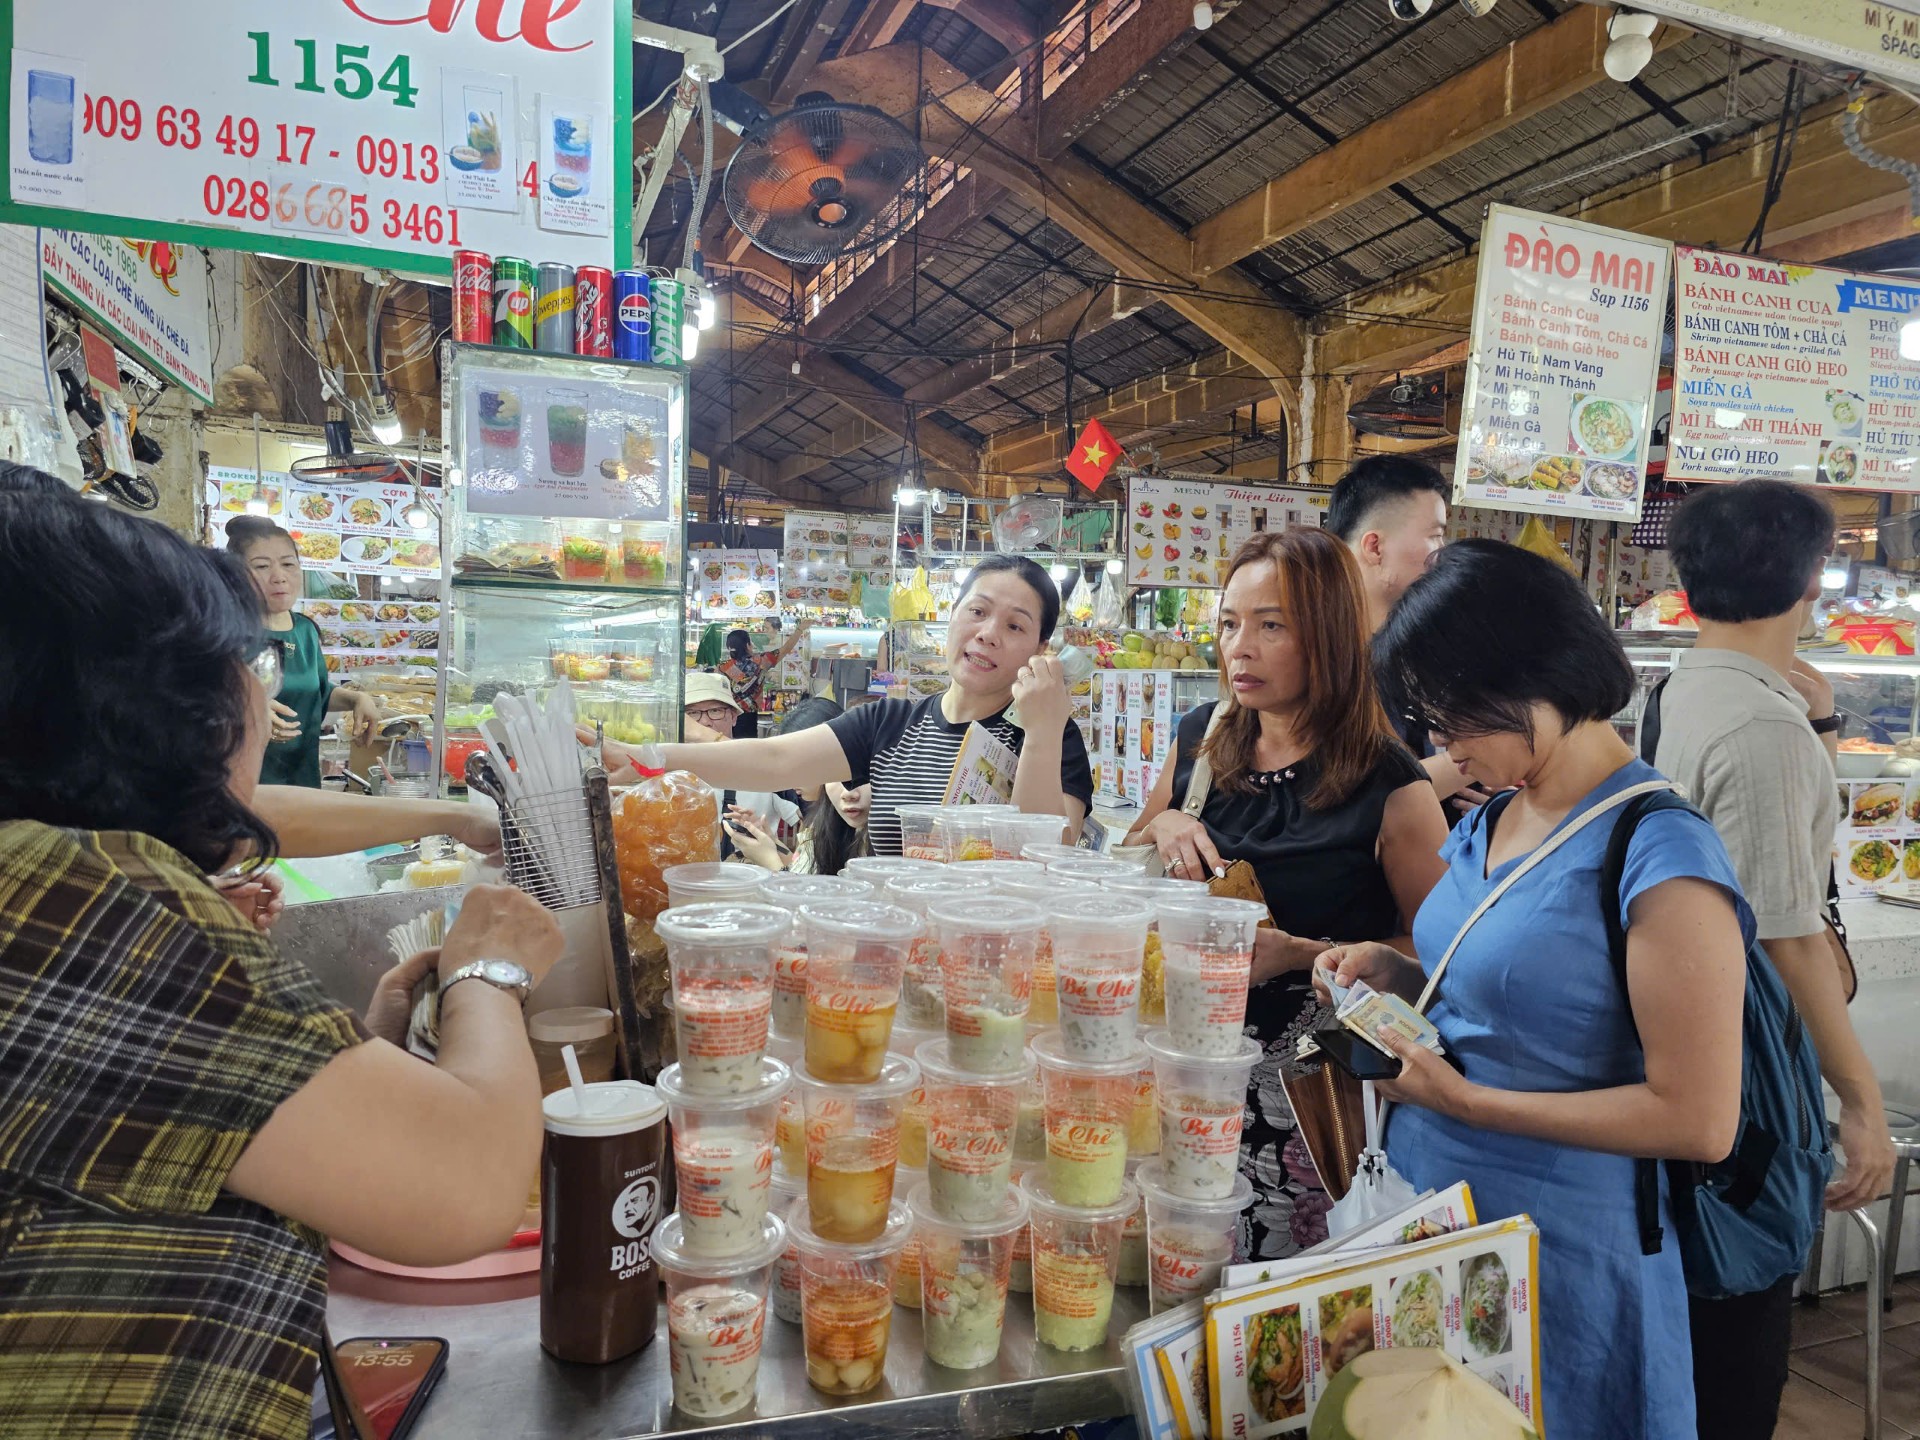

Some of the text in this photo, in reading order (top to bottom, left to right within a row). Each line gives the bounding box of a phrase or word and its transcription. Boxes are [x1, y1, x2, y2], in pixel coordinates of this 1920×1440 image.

[1881, 34, 1920, 59] SPAG
[247, 31, 419, 108] 1154
[157, 105, 201, 149] 63
[216, 114, 260, 158] 49
[277, 123, 316, 165] 17
[357, 134, 439, 184] 0913
[383, 198, 463, 247] 3461
[70, 231, 90, 264] CÁC
[92, 255, 113, 287] LOẠI
[116, 276, 133, 303] CHÈ
[116, 246, 138, 283] 1968
[1503, 225, 1655, 294] ĐÀO MAI
[1694, 256, 1740, 279] ĐÀO
[538, 294, 571, 316] hweppes
[1503, 294, 1599, 323] Bánh Canh Cua
[1590, 288, 1649, 312] Sạp 1156
[1684, 282, 1832, 316] BÁNH CANH CUA
[107, 299, 121, 325] CÁC
[621, 308, 651, 320] PEPS
[1692, 301, 1842, 328] Crab vietnamese udon (noodle soup)
[1869, 316, 1899, 333] PHỞ
[1501, 311, 1535, 329] Bánh
[1539, 318, 1570, 335] Canh
[1607, 329, 1629, 346] Chả
[1633, 333, 1648, 349] Cá
[1685, 313, 1720, 332] BÁNH
[1724, 320, 1760, 337] CANH
[1763, 322, 1790, 340] TÔM
[1803, 326, 1828, 344] CHẢ
[1831, 329, 1847, 346] CÁ
[1500, 328, 1619, 360] Bánh Canh Giò Heo
[1690, 332, 1841, 357] Shrimp vietnamese udon grilled fish
[1498, 346, 1604, 377] Hủ Tíu Nam Vang
[1684, 344, 1847, 377] BÁNH CANH GIÒ HEO
[1495, 365, 1596, 391] Mì Hoành Thánh
[1690, 364, 1829, 386] Pork sausage legs vietnamese udon
[1870, 372, 1920, 391] PHỞ TÔ
[1493, 381, 1508, 395] Mì
[1682, 377, 1752, 399] MIẾN GÀ
[1688, 397, 1795, 414] Soya noodles with chicken
[1489, 415, 1541, 433] Miến Gà
[1679, 410, 1822, 437] MÌ HNH THÁNH
[1711, 445, 1740, 463] GIÒ
[1745, 449, 1779, 465] HEO
[1681, 462, 1699, 472] Pork
[1701, 464, 1736, 475] sausage
[1738, 465, 1754, 476] legs
[1174, 486, 1211, 496] MENU
[1060, 975, 1136, 999] Bé Chè
[829, 992, 879, 1015] Chè
[1068, 1125, 1115, 1145] Chè
[1180, 1114, 1243, 1136] Bé Ch
[967, 1135, 1008, 1156] Chè
[610, 1237, 650, 1271] BOS
[1158, 1254, 1203, 1279] Chè
[618, 1261, 651, 1280] COFFEE
[708, 1323, 748, 1347] Bé
[1233, 1323, 1243, 1348] 1156
[354, 1354, 414, 1367] 13:55
[1313, 1336, 1321, 1372] 60.000Đ
